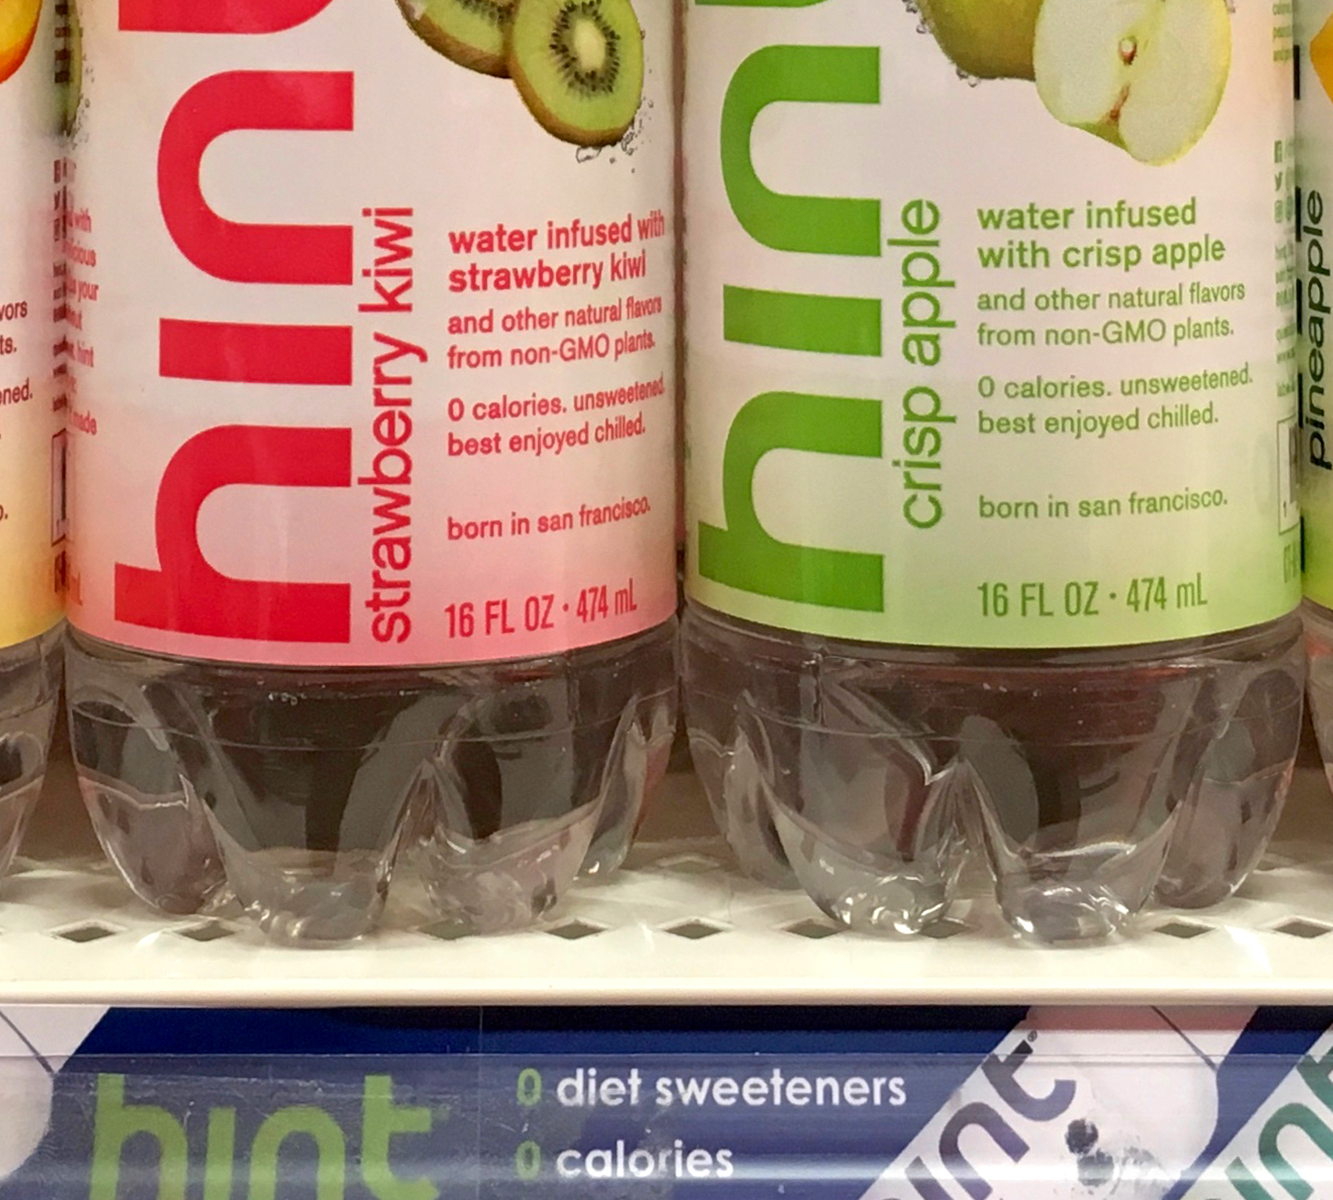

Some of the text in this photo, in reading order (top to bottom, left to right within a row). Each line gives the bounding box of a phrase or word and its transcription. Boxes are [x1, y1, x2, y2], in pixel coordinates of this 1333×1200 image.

[978, 197, 1195, 230] water infused
[449, 213, 632, 253] water infused
[449, 249, 646, 292] strawberry kiwi
[978, 234, 1225, 272] with crisp apple
[977, 282, 1245, 311] and other natural flavors
[448, 298, 622, 334] and other natural
[977, 317, 1234, 347] from non-GMO plants.
[1301, 190, 1333, 472] pineapple
[447, 332, 609, 369] from non-GMO
[887, 199, 957, 529] crisp apple
[1004, 362, 1253, 399] calories. unsweetened.
[472, 393, 566, 420] calories.
[978, 401, 1218, 439] best enjoyed chilled.
[357, 208, 427, 644] strawberry kiwi
[448, 421, 589, 456] best enjoyed
[979, 487, 1227, 518] born san francisco.
[978, 577, 1167, 617] 16 FL OZ 474
[517, 1068, 906, 1107] 0 diet sweeteners
[90, 1073, 439, 1200] hint
[555, 1140, 739, 1181] calories
